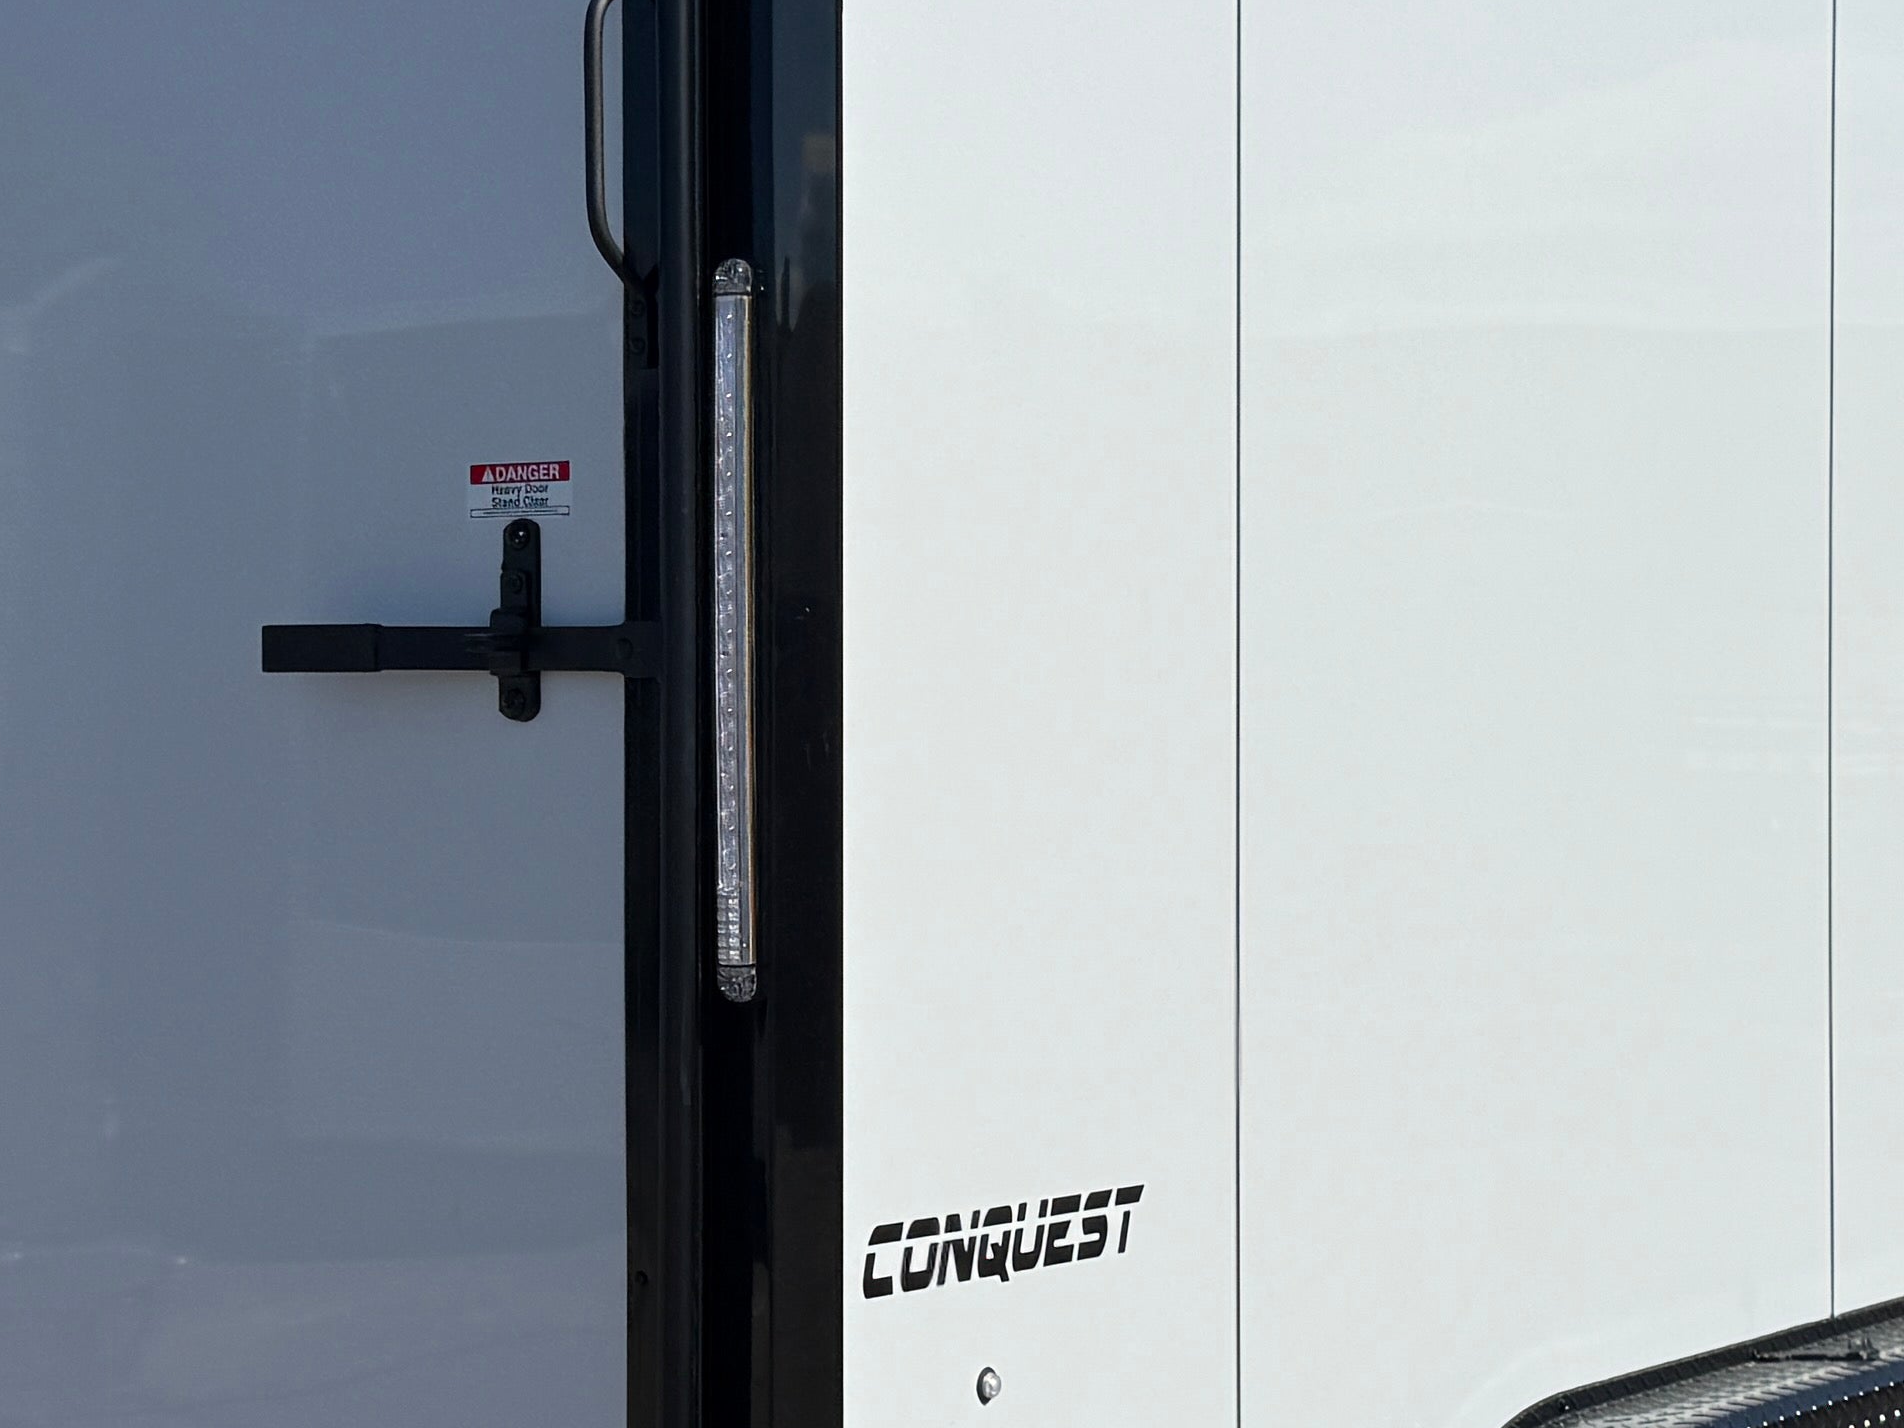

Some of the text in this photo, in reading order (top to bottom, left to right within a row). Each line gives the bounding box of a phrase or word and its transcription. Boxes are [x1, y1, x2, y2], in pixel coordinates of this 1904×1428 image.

[496, 463, 560, 482] DANGER
[524, 483, 548, 494] Door
[491, 494, 520, 509] Stand
[862, 1184, 1145, 1300] CONQUEST
